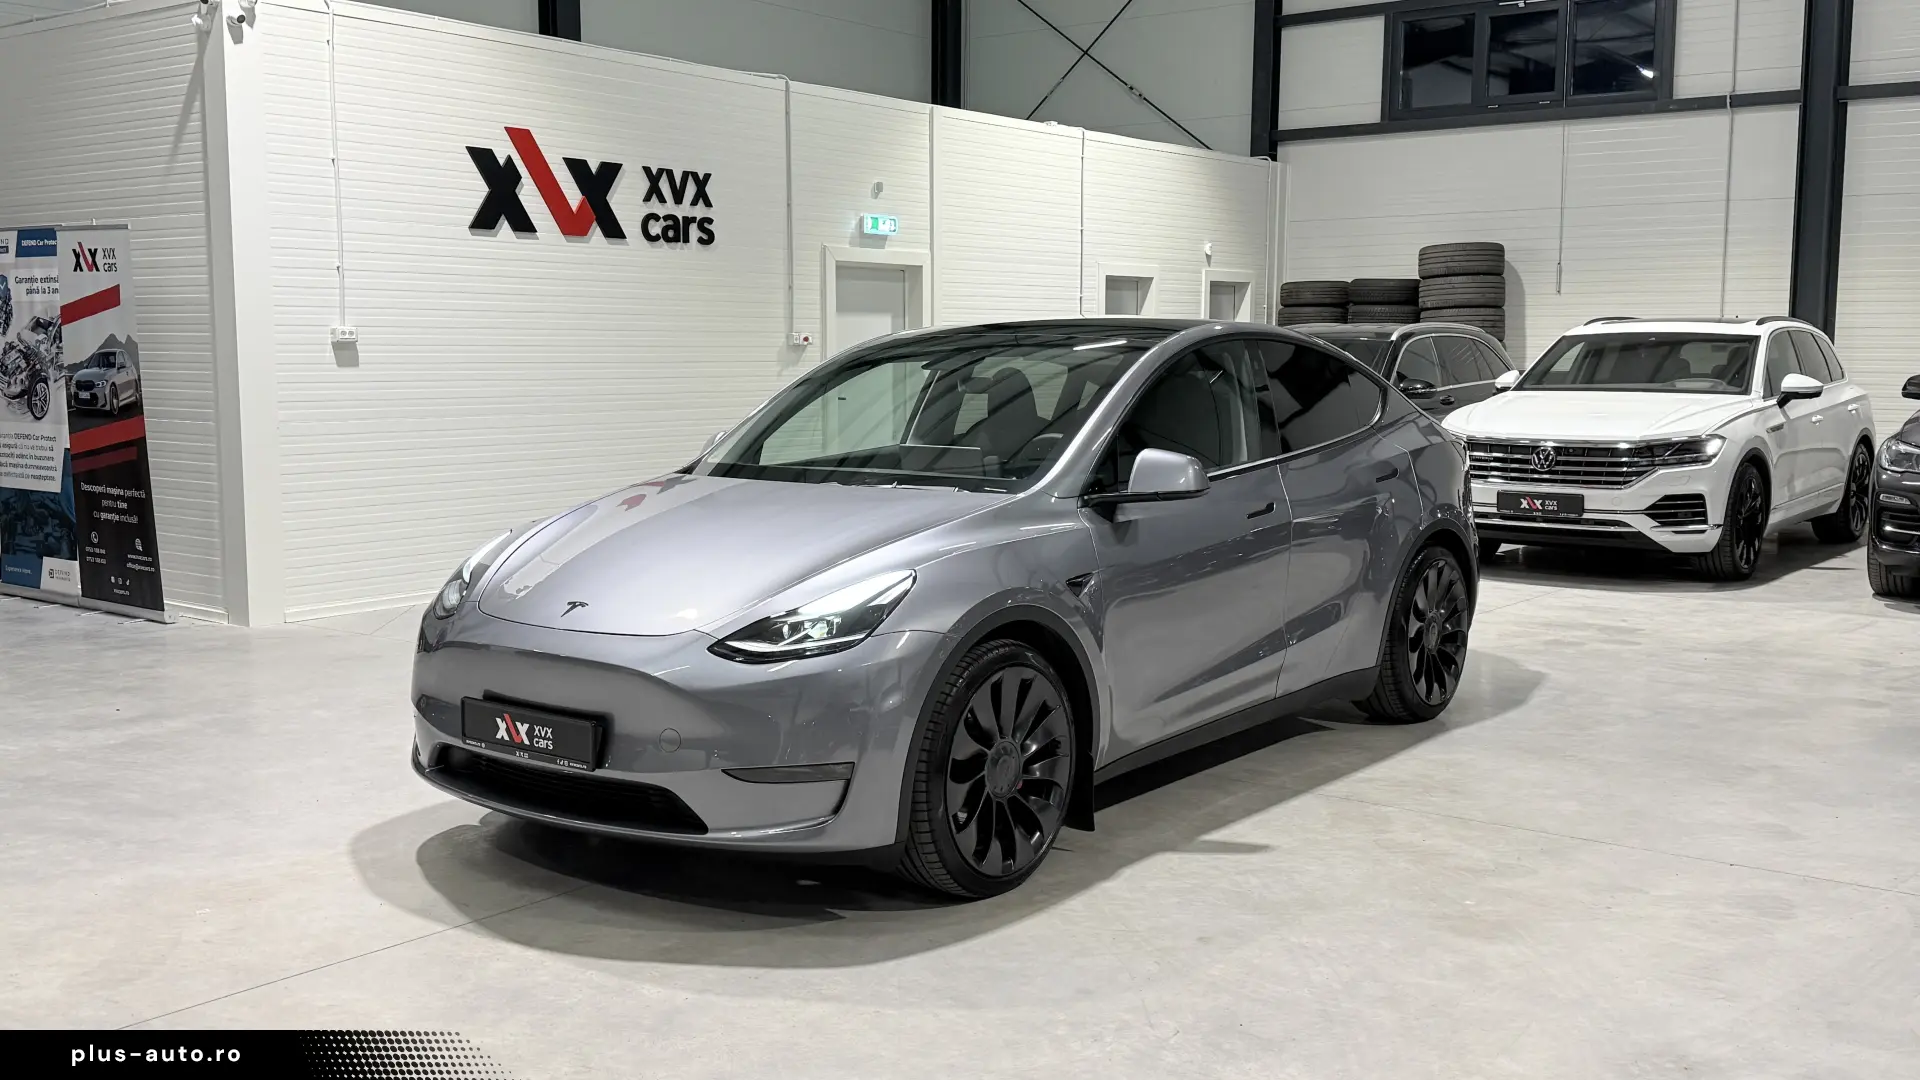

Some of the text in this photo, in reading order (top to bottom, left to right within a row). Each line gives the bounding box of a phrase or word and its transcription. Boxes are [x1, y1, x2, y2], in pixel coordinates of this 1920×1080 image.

[641, 166, 713, 207] XVX
[641, 212, 715, 245] cars
[102, 248, 116, 260] XVX
[103, 263, 118, 272] cars
[40, 286, 46, 295] la
[47, 286, 51, 294] 3
[117, 500, 128, 509] tine
[533, 725, 553, 739] XVX
[533, 738, 554, 750] cars
